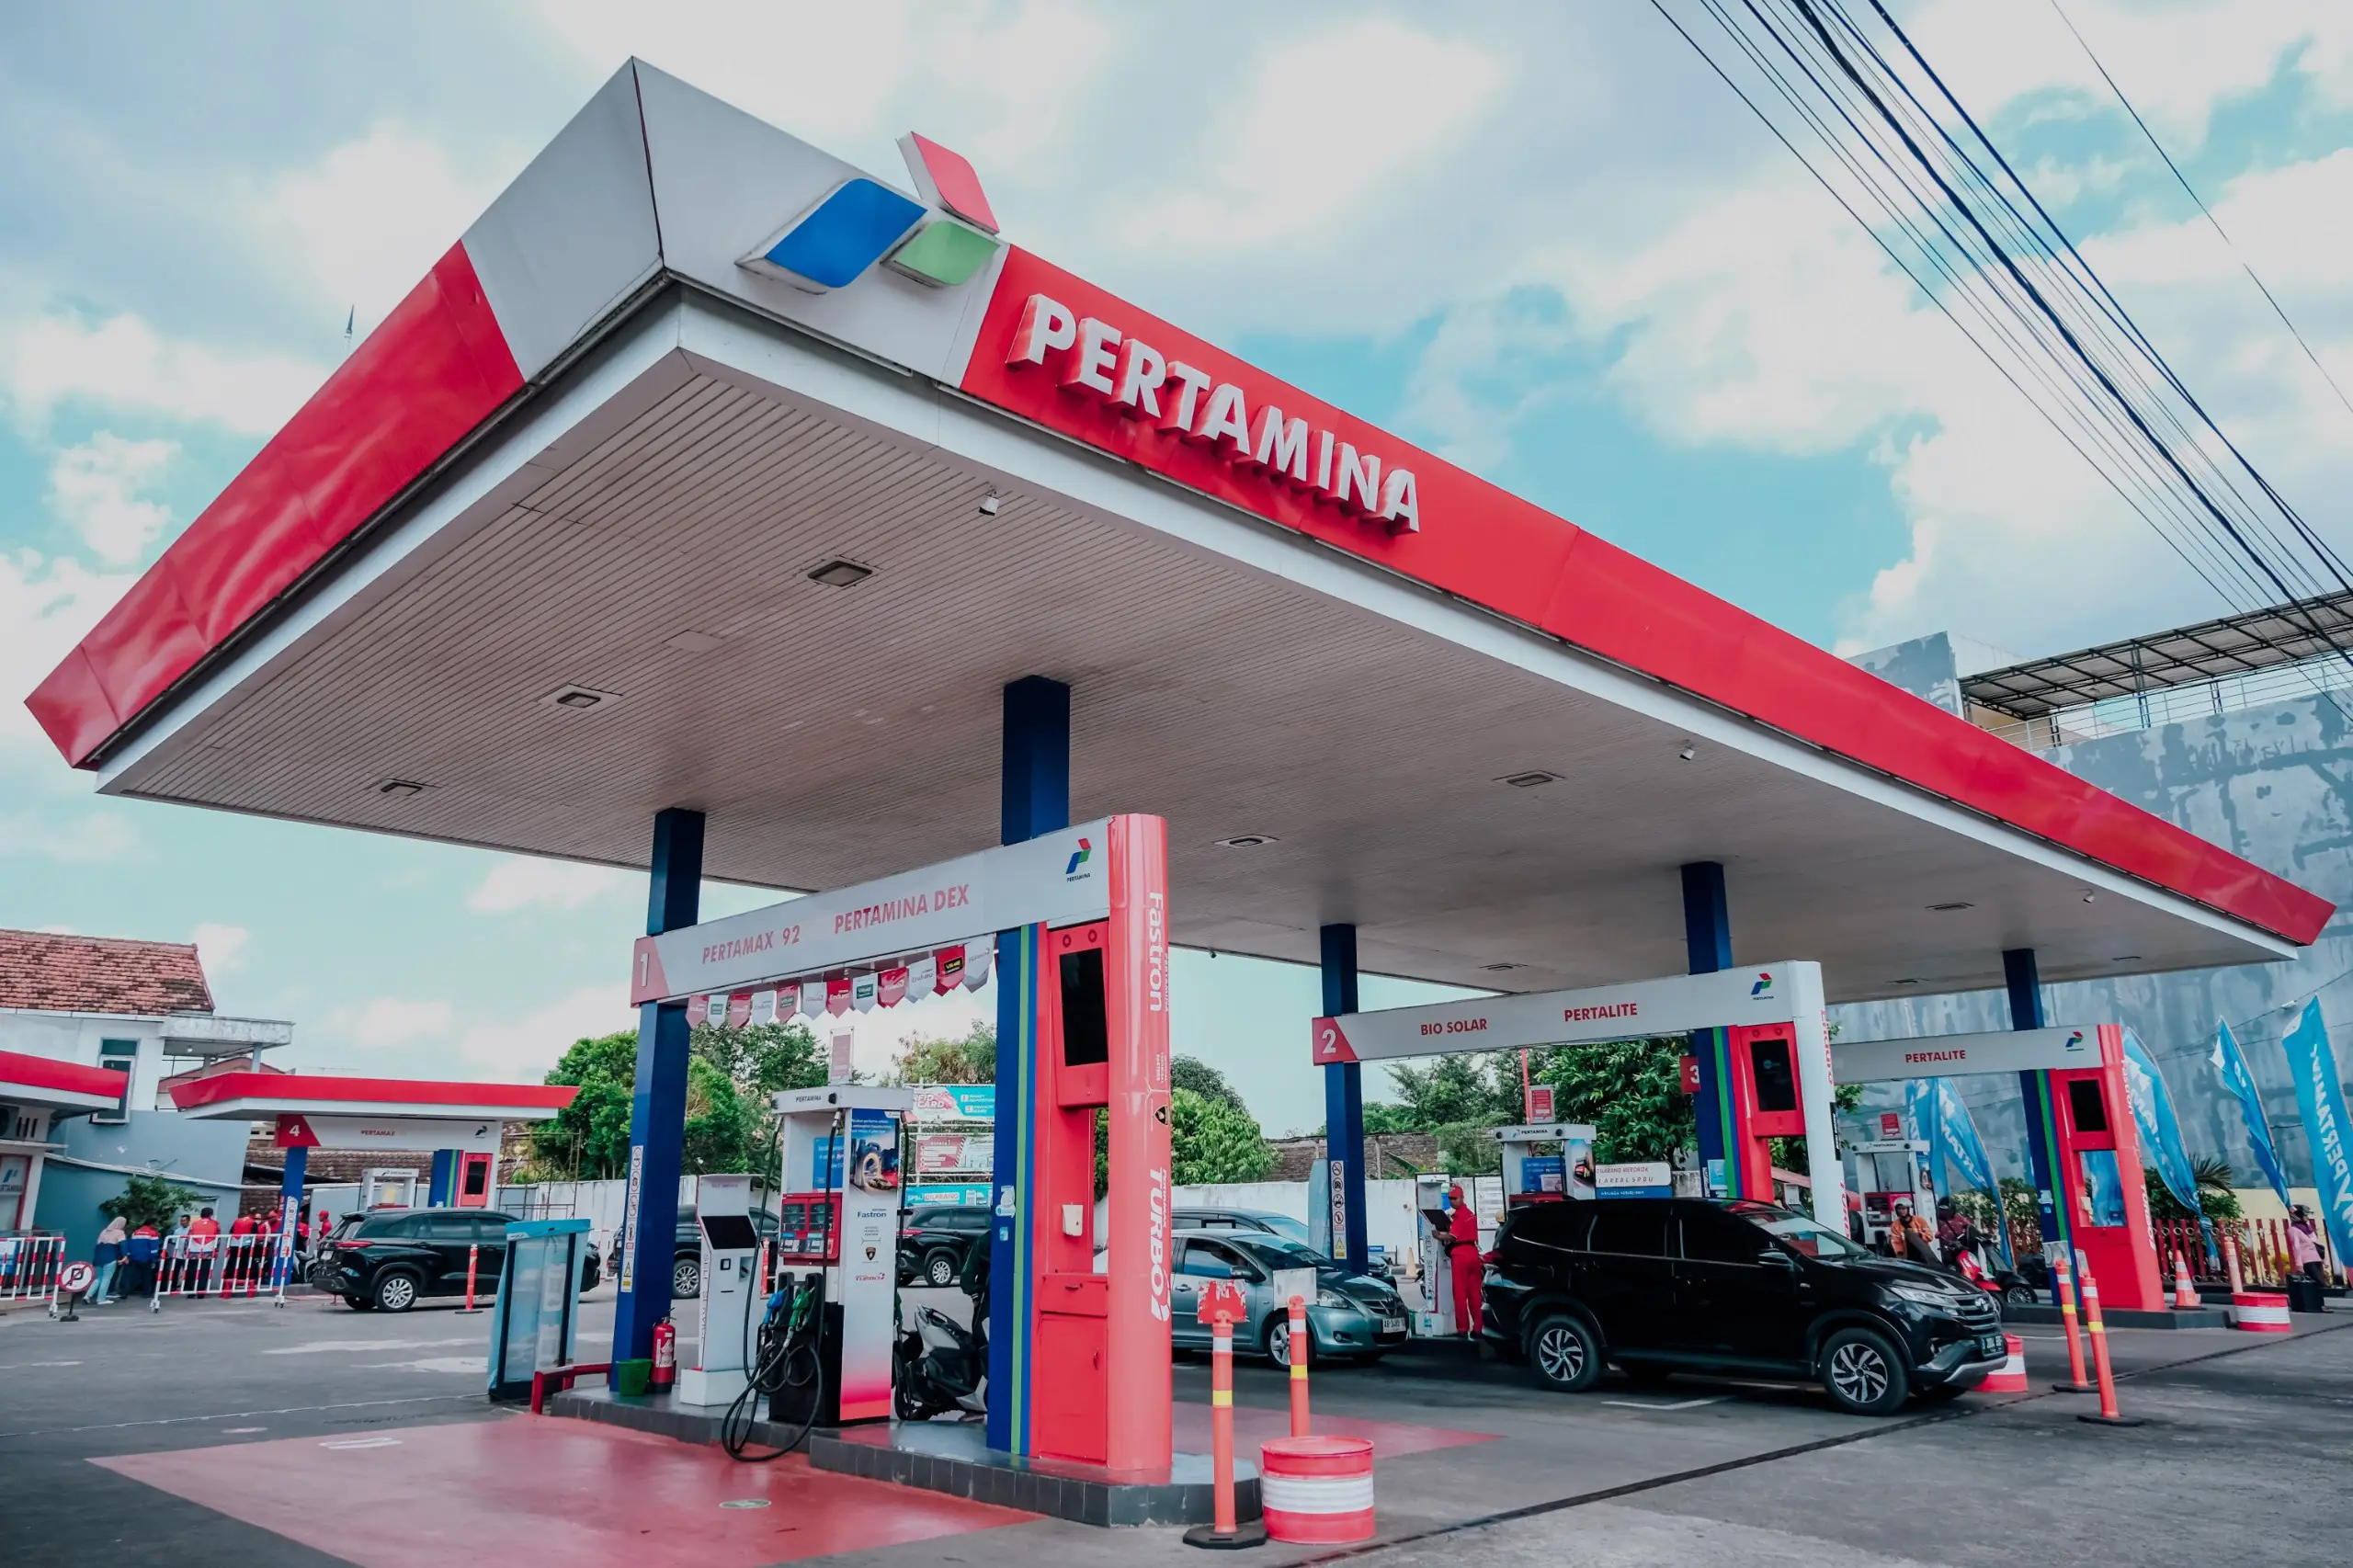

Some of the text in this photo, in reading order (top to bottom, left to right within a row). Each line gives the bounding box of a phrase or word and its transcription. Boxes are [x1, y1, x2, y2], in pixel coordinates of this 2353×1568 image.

[1018, 291, 1420, 534] PERTAMINA
[1066, 872, 1091, 882] PERTAMINA
[834, 883, 970, 935] PERTAMINA DEX
[701, 925, 801, 964] PERTAMAX 92
[1149, 892, 1164, 1012] Fastron
[640, 952, 649, 988] 1
[1564, 1003, 1638, 1022] PERTALITE
[1420, 1018, 1487, 1036] BIO SOLAR
[1321, 1028, 1336, 1054] 2
[1904, 1050, 1966, 1063] PERTALITE
[1689, 1064, 1699, 1085] 3
[290, 1124, 301, 1137] 4
[1150, 1166, 1165, 1298] TURBO
